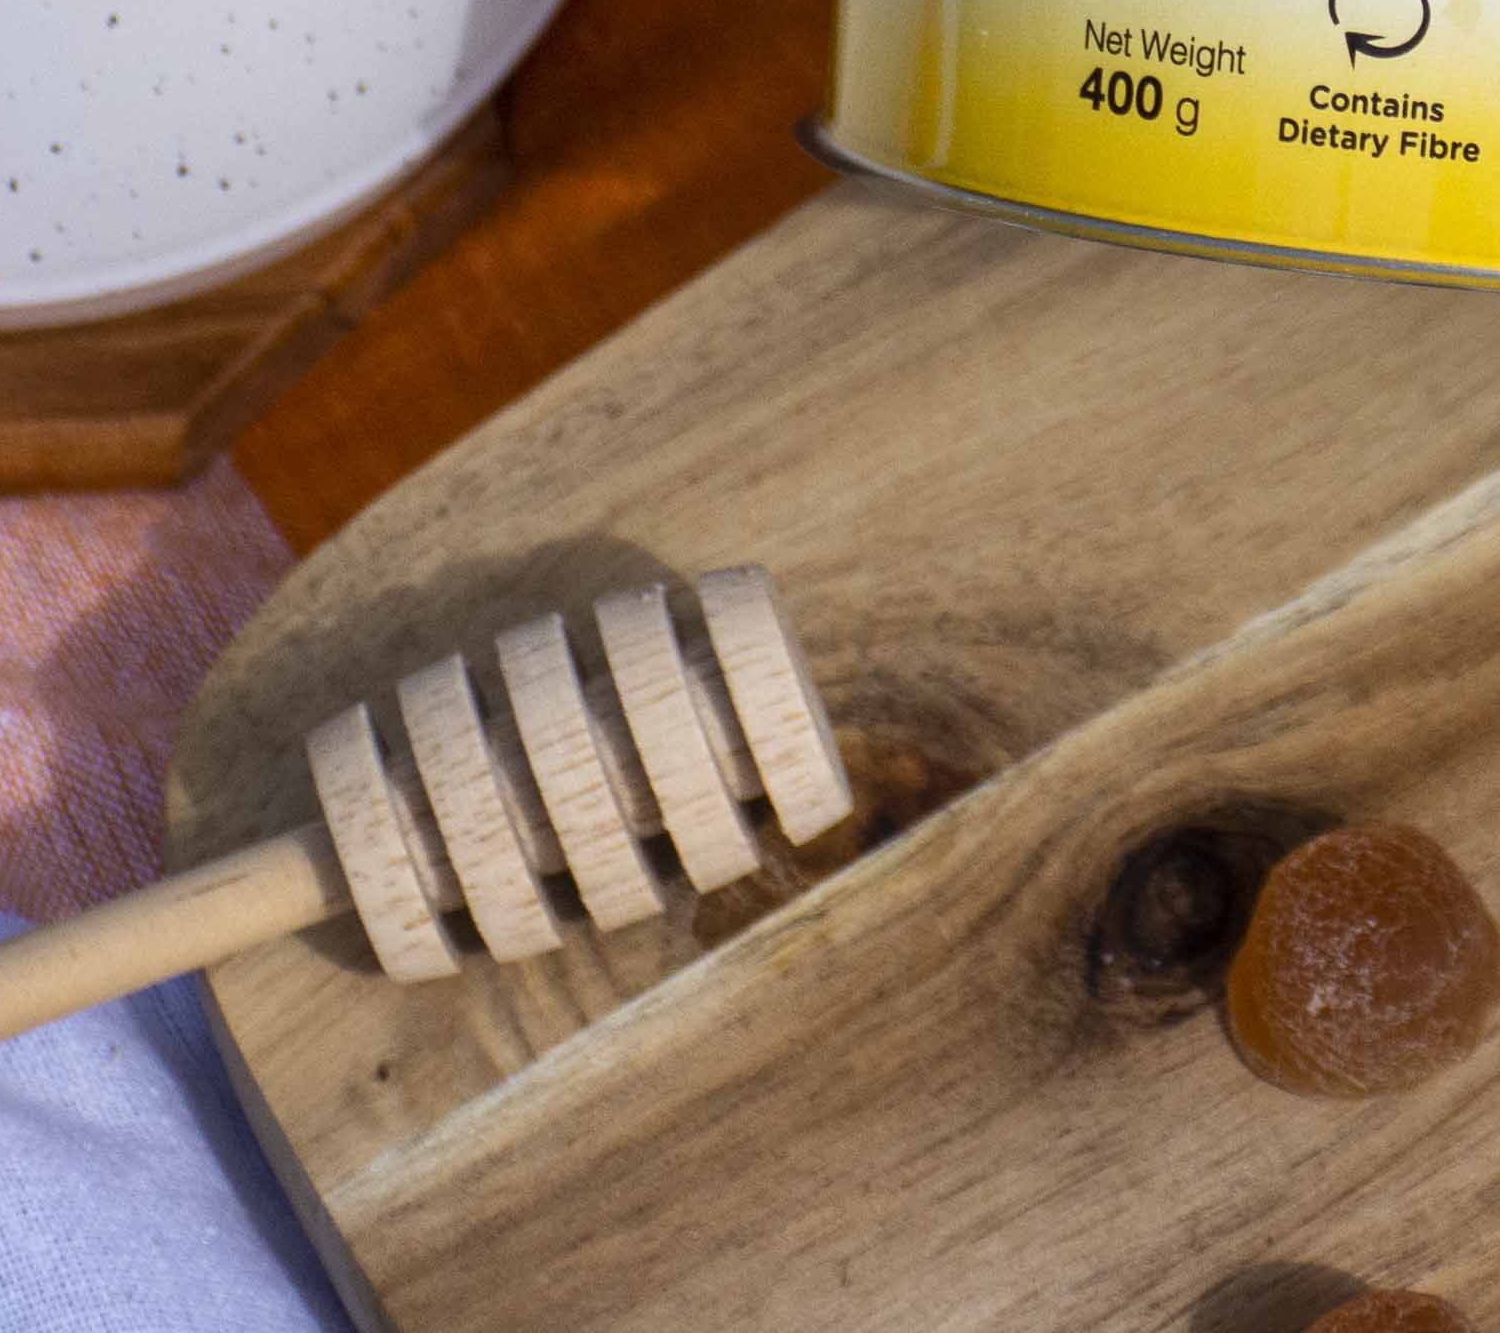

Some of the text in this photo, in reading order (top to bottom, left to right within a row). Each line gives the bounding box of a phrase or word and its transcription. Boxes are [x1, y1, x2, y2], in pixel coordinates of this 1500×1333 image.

[1084, 19, 1247, 77] Net Weight
[1079, 66, 1200, 137] 400 g
[1309, 85, 1445, 123] Contains
[1278, 117, 1480, 162] Dietary Fibre
